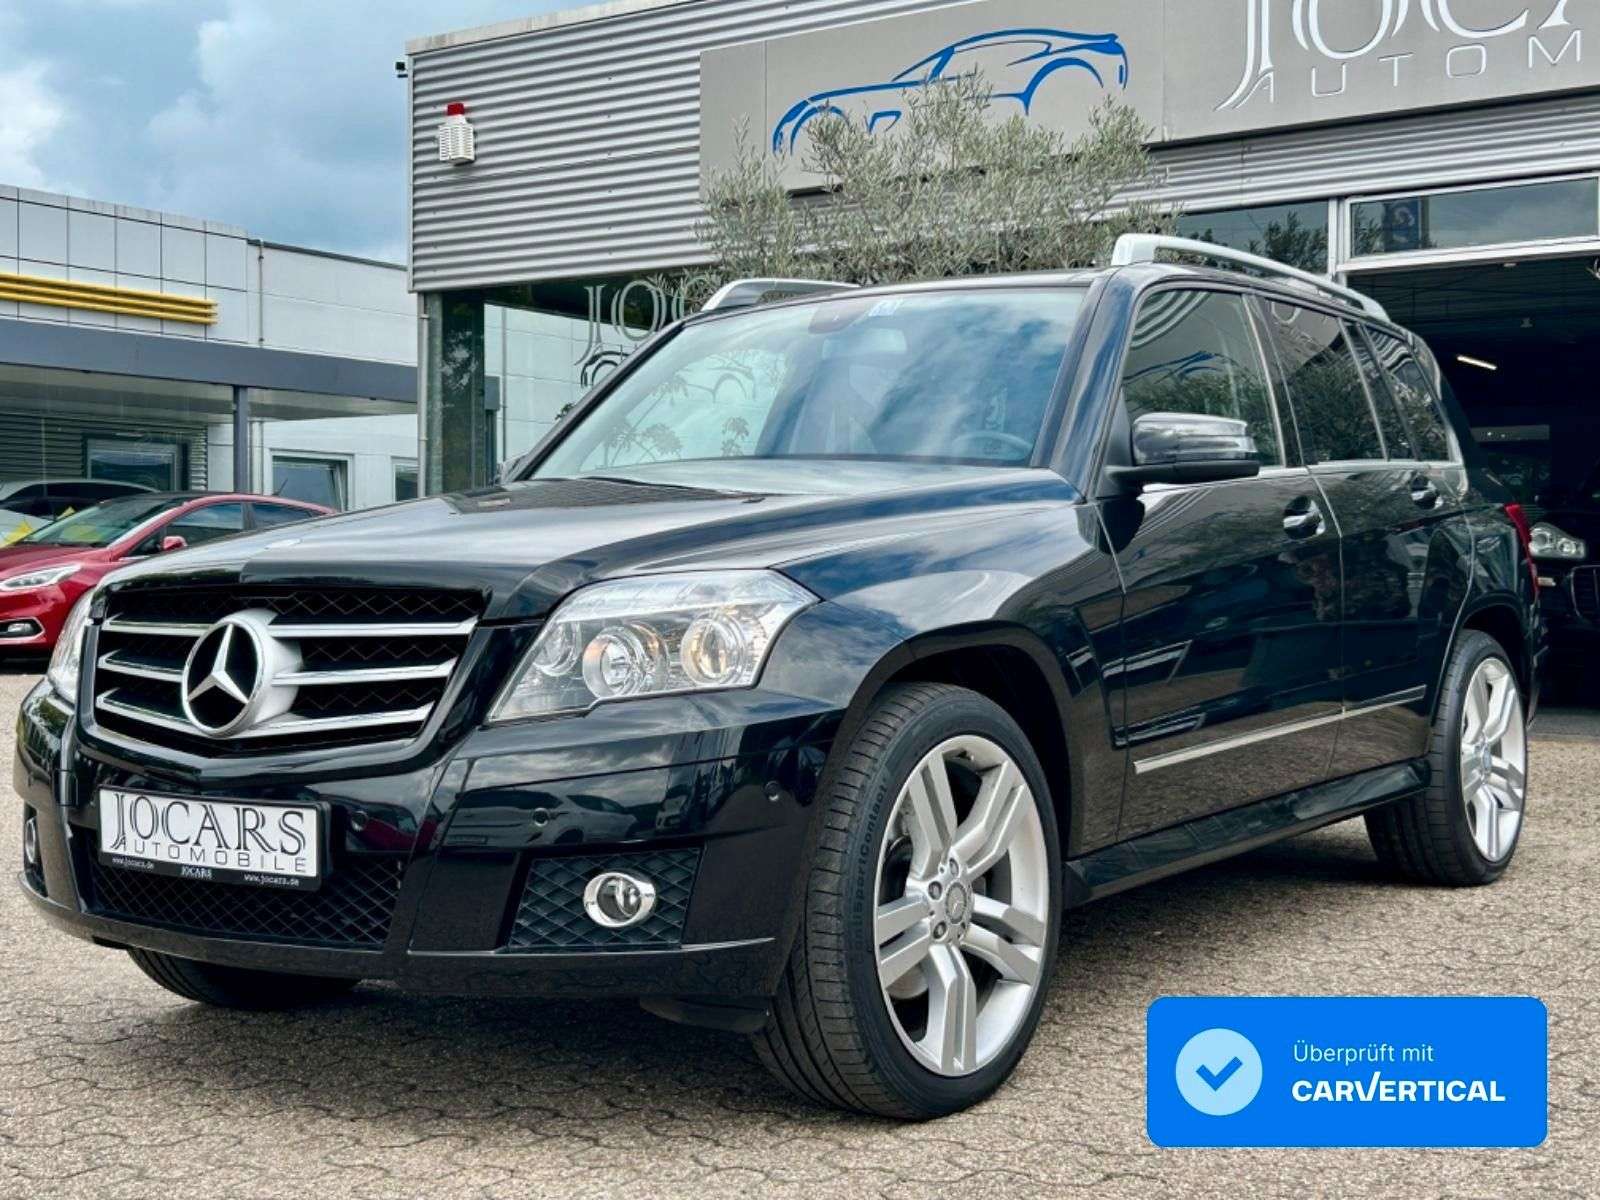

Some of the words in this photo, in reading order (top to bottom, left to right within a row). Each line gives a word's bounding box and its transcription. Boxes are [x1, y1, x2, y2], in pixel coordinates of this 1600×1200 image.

[1214, 0, 1571, 111] JO
[111, 793, 306, 857] JOCARS
[115, 836, 306, 873] AUTOMOBILE
